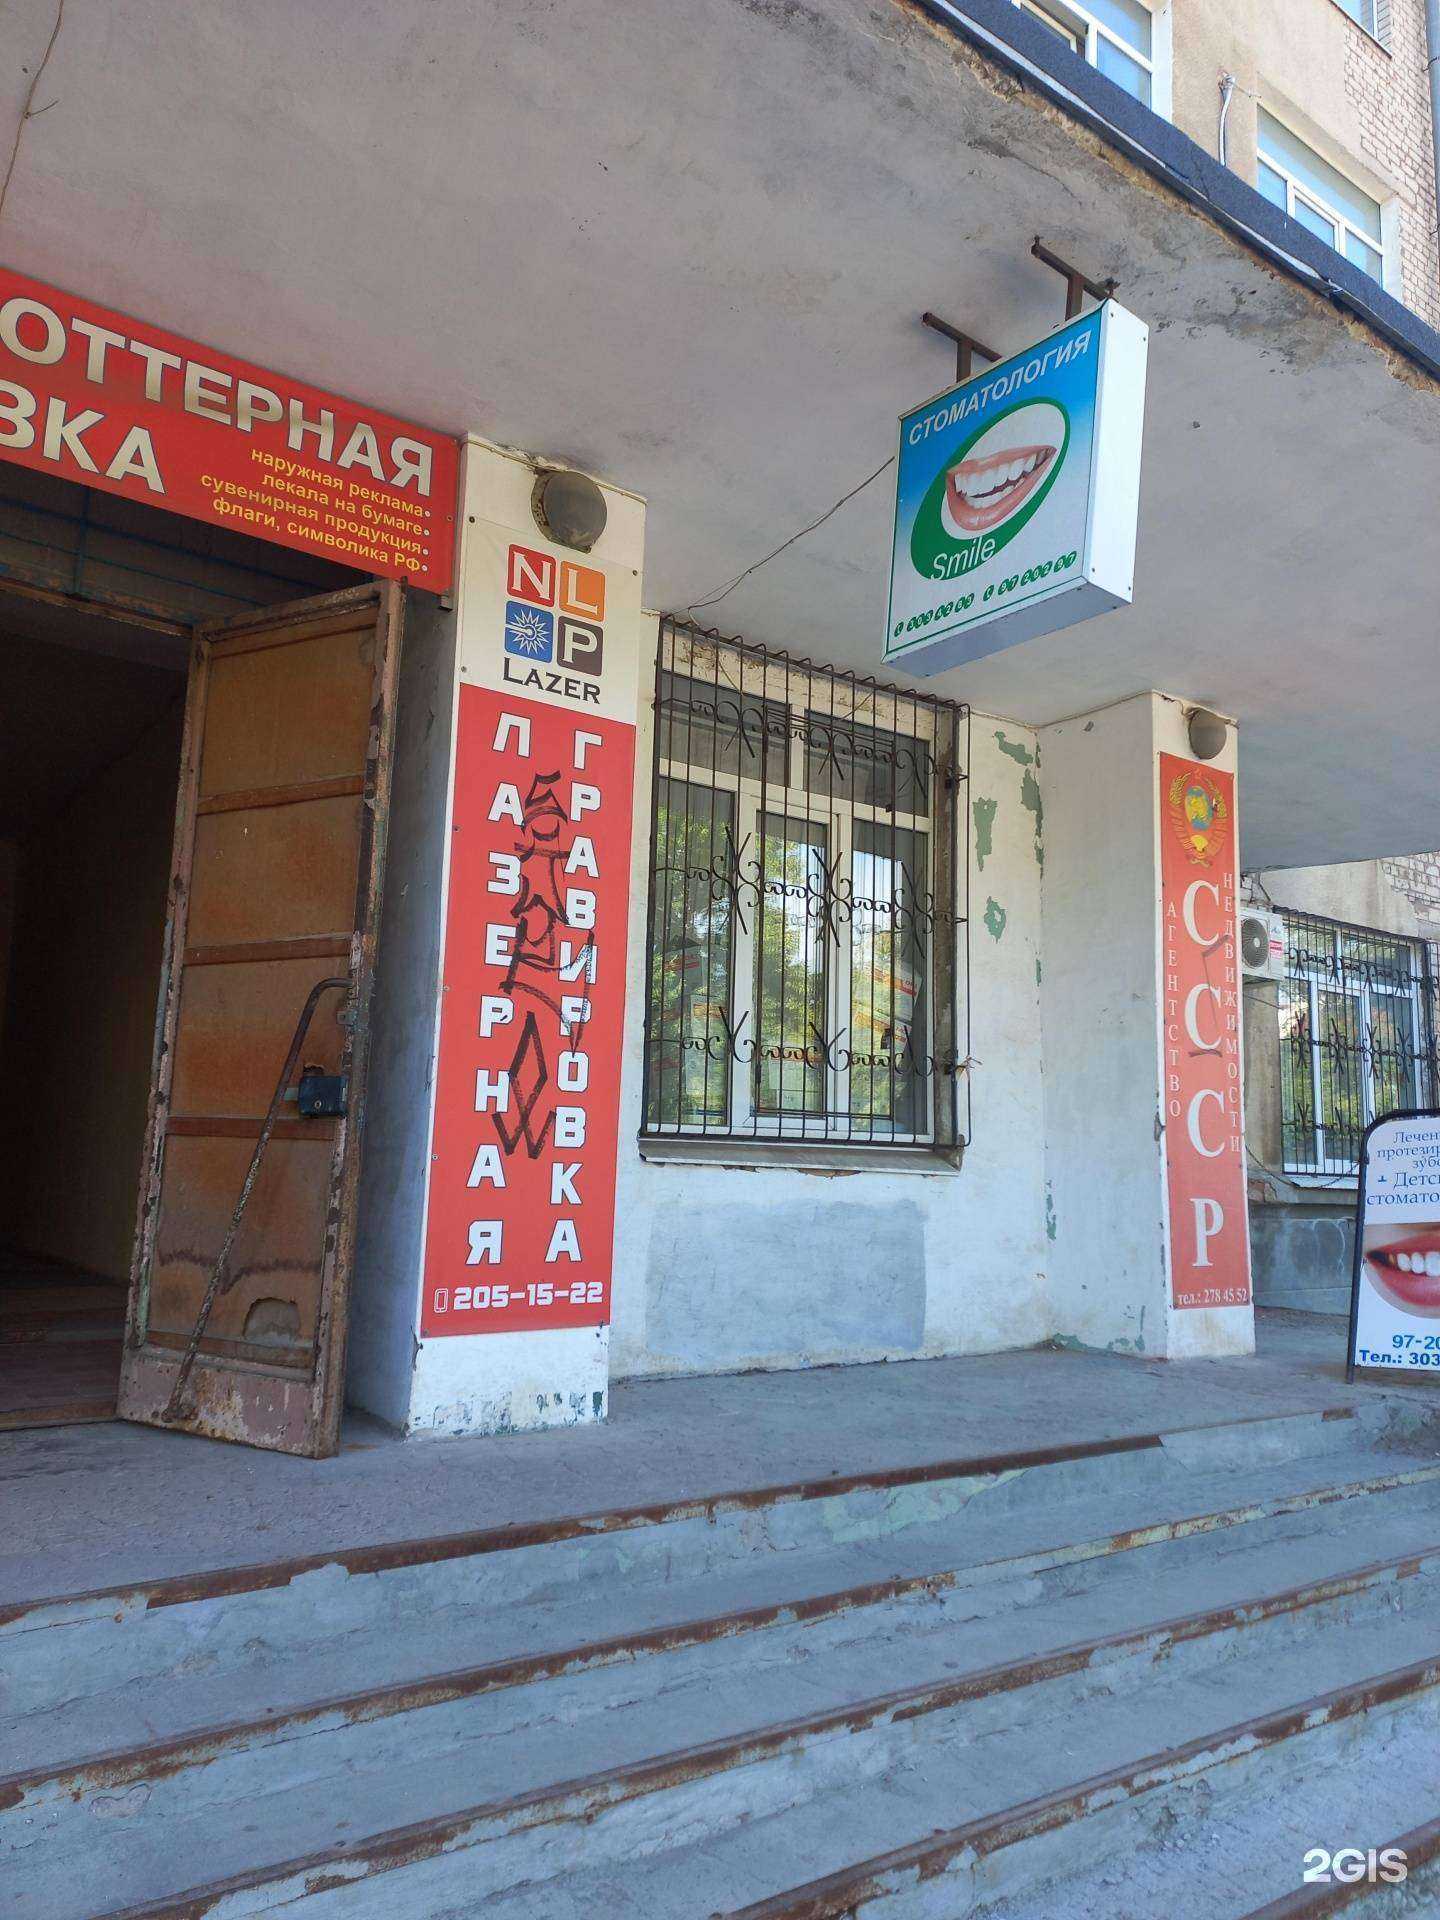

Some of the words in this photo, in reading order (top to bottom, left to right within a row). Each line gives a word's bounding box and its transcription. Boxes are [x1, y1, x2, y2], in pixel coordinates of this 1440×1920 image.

[0, 297, 433, 497] ОТТЕРНАЯ
[908, 328, 1093, 446] СТОМАТОЛОГИЯ
[201, 474, 319, 521] сувенирная
[325, 513, 422, 555] продукция
[251, 448, 343, 490] наружная
[349, 482, 424, 518] реклама
[262, 473, 330, 506] лекала
[335, 498, 356, 514] на
[361, 504, 423, 536] бумаге
[213, 497, 280, 532] флаги,
[287, 521, 388, 564] символика
[394, 553, 420, 573] РФ
[930, 534, 996, 581] Smile
[502, 656, 601, 705] LAZER
[465, 711, 532, 1266] ЛАЗЕРНАЯ
[544, 729, 603, 1264] ГРАВИРОВКА
[1166, 901, 1181, 1118] АГЕНТСТВО
[1222, 872, 1241, 1153] НЕДВИЖИМОСТИ
[1182, 879, 1226, 1269] СССР
[1367, 1192, 1440, 1206] стомато
[453, 1281, 604, 1311] 205-15-22
[1204, 1289, 1221, 1304] 278
[1223, 1288, 1235, 1302] 45
[1359, 1349, 1402, 1363] Тел.:
[1409, 1352, 1440, 1366] 303
